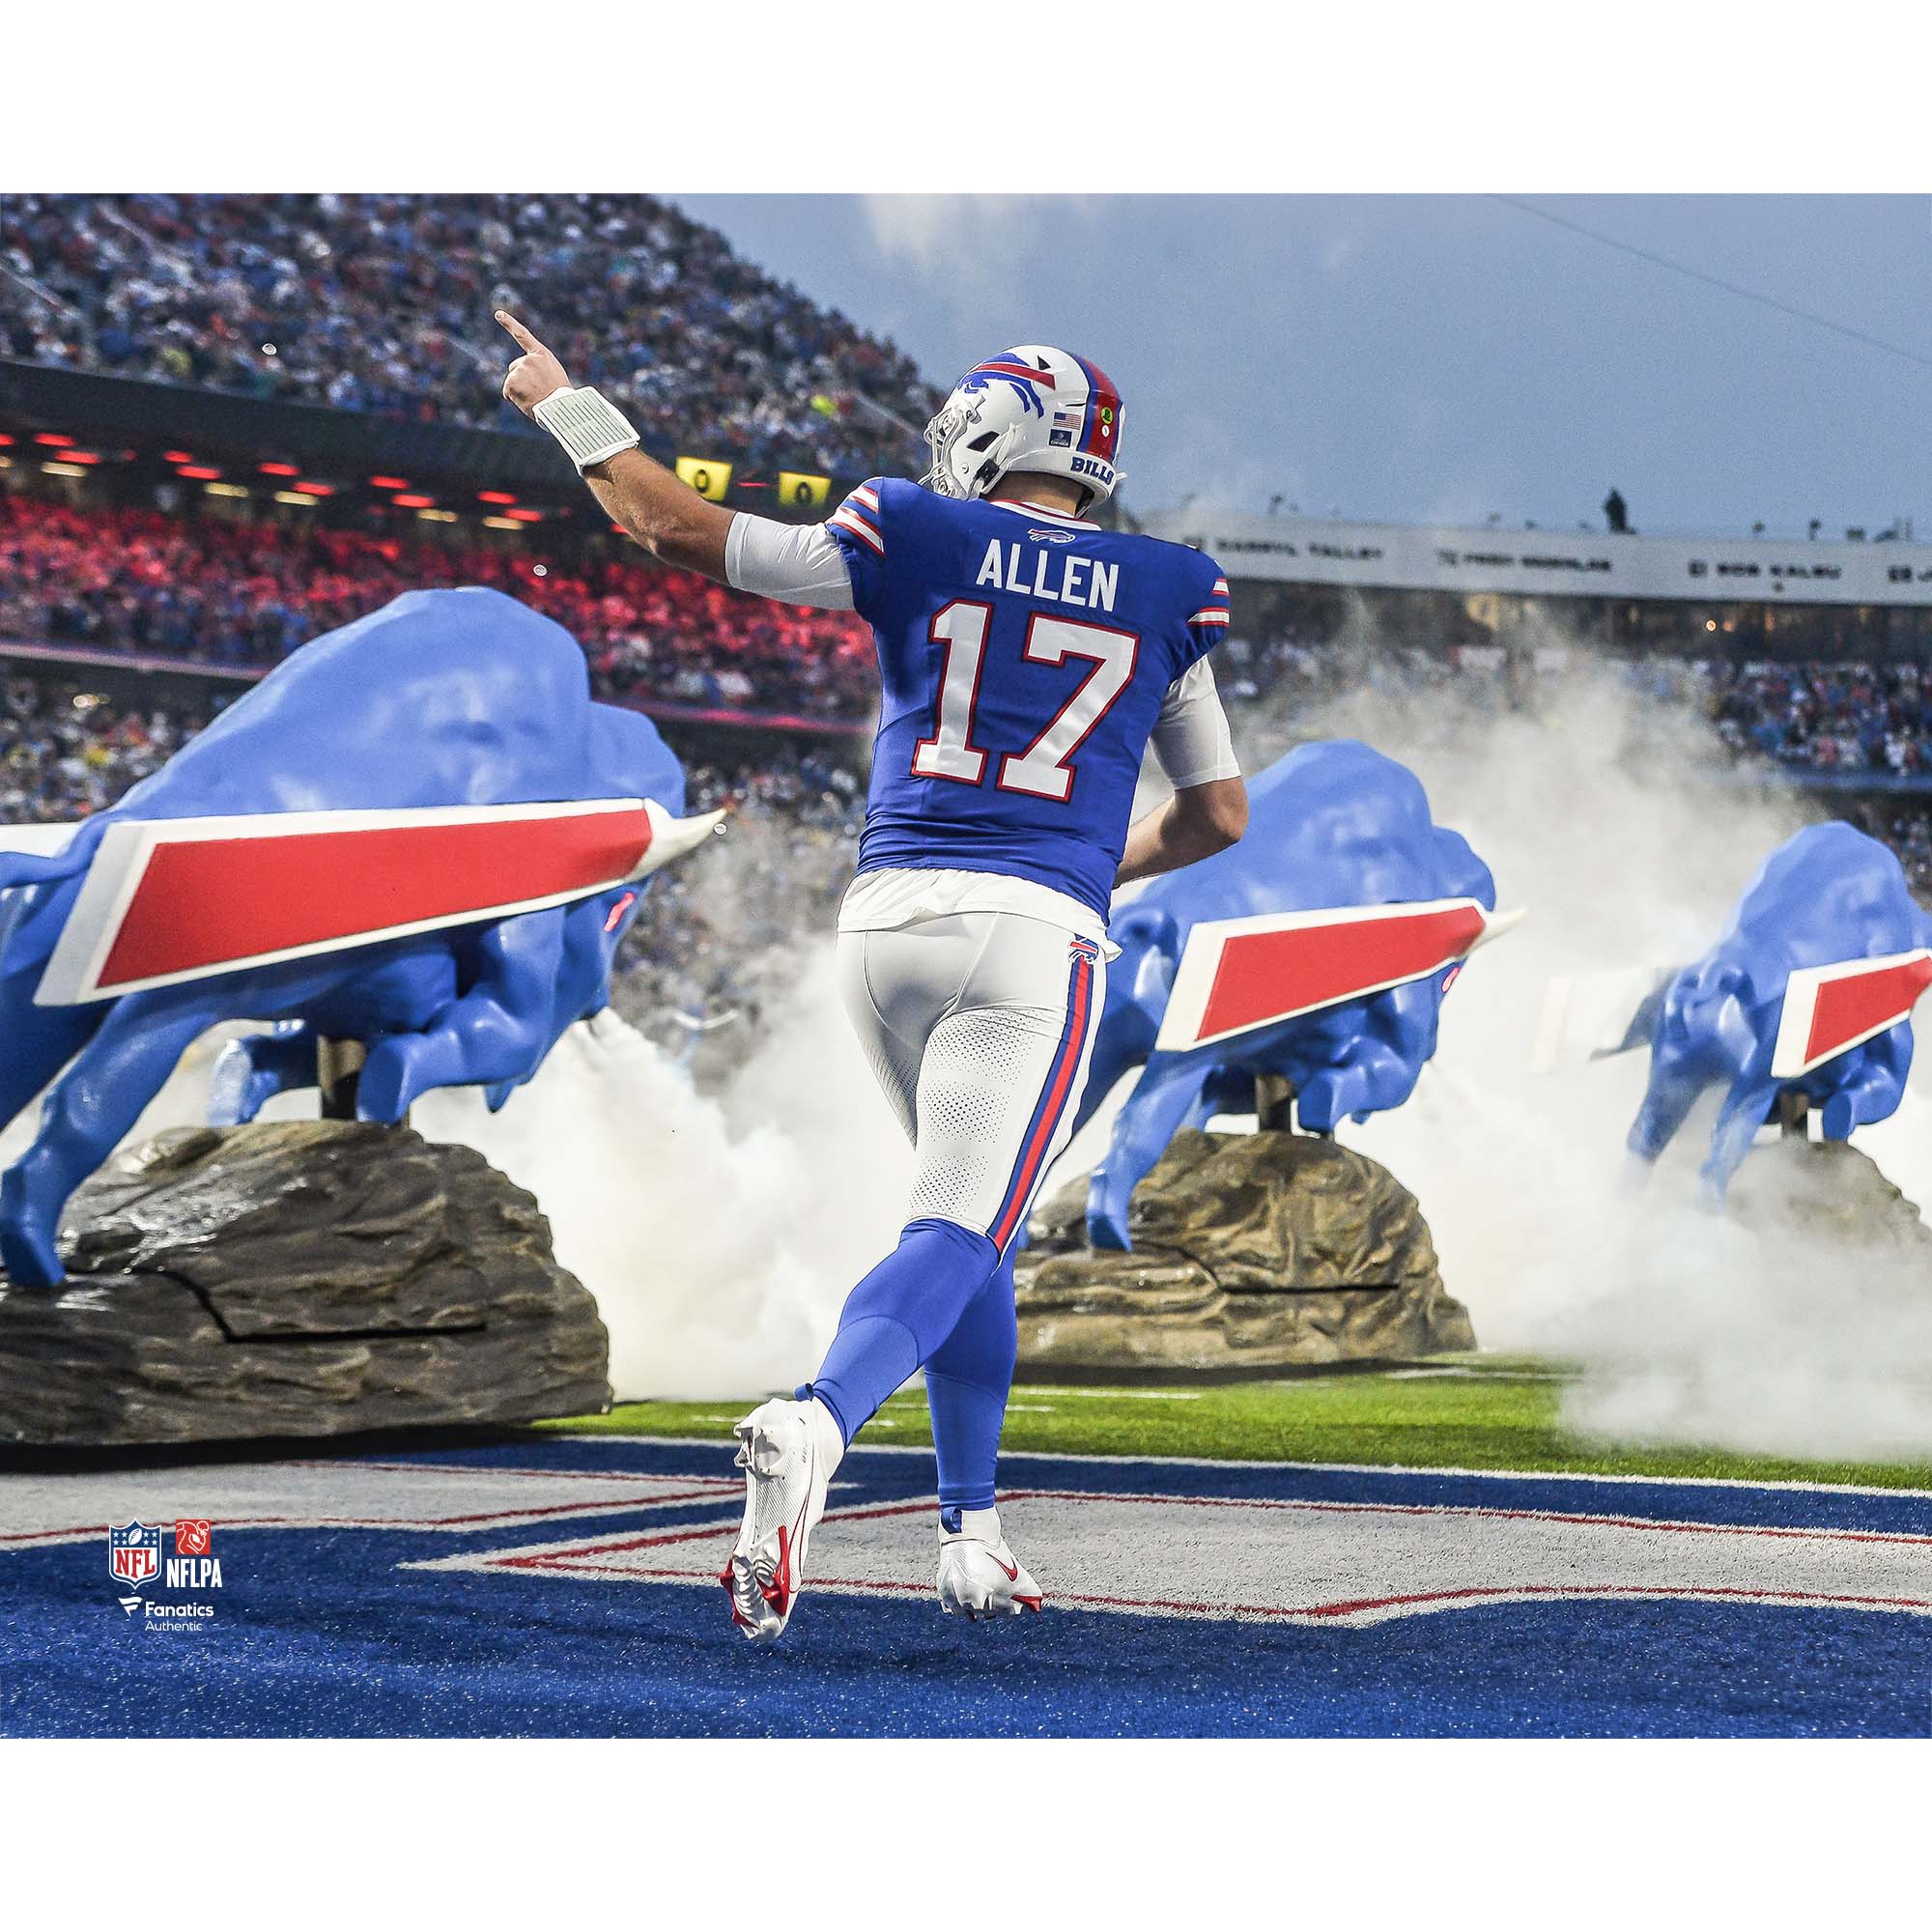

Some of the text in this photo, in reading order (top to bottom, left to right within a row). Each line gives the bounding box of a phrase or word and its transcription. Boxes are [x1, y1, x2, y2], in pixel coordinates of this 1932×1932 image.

[1070, 456, 1115, 485] BILLS
[976, 538, 1120, 612] ALLEN
[911, 597, 1141, 804] 17
